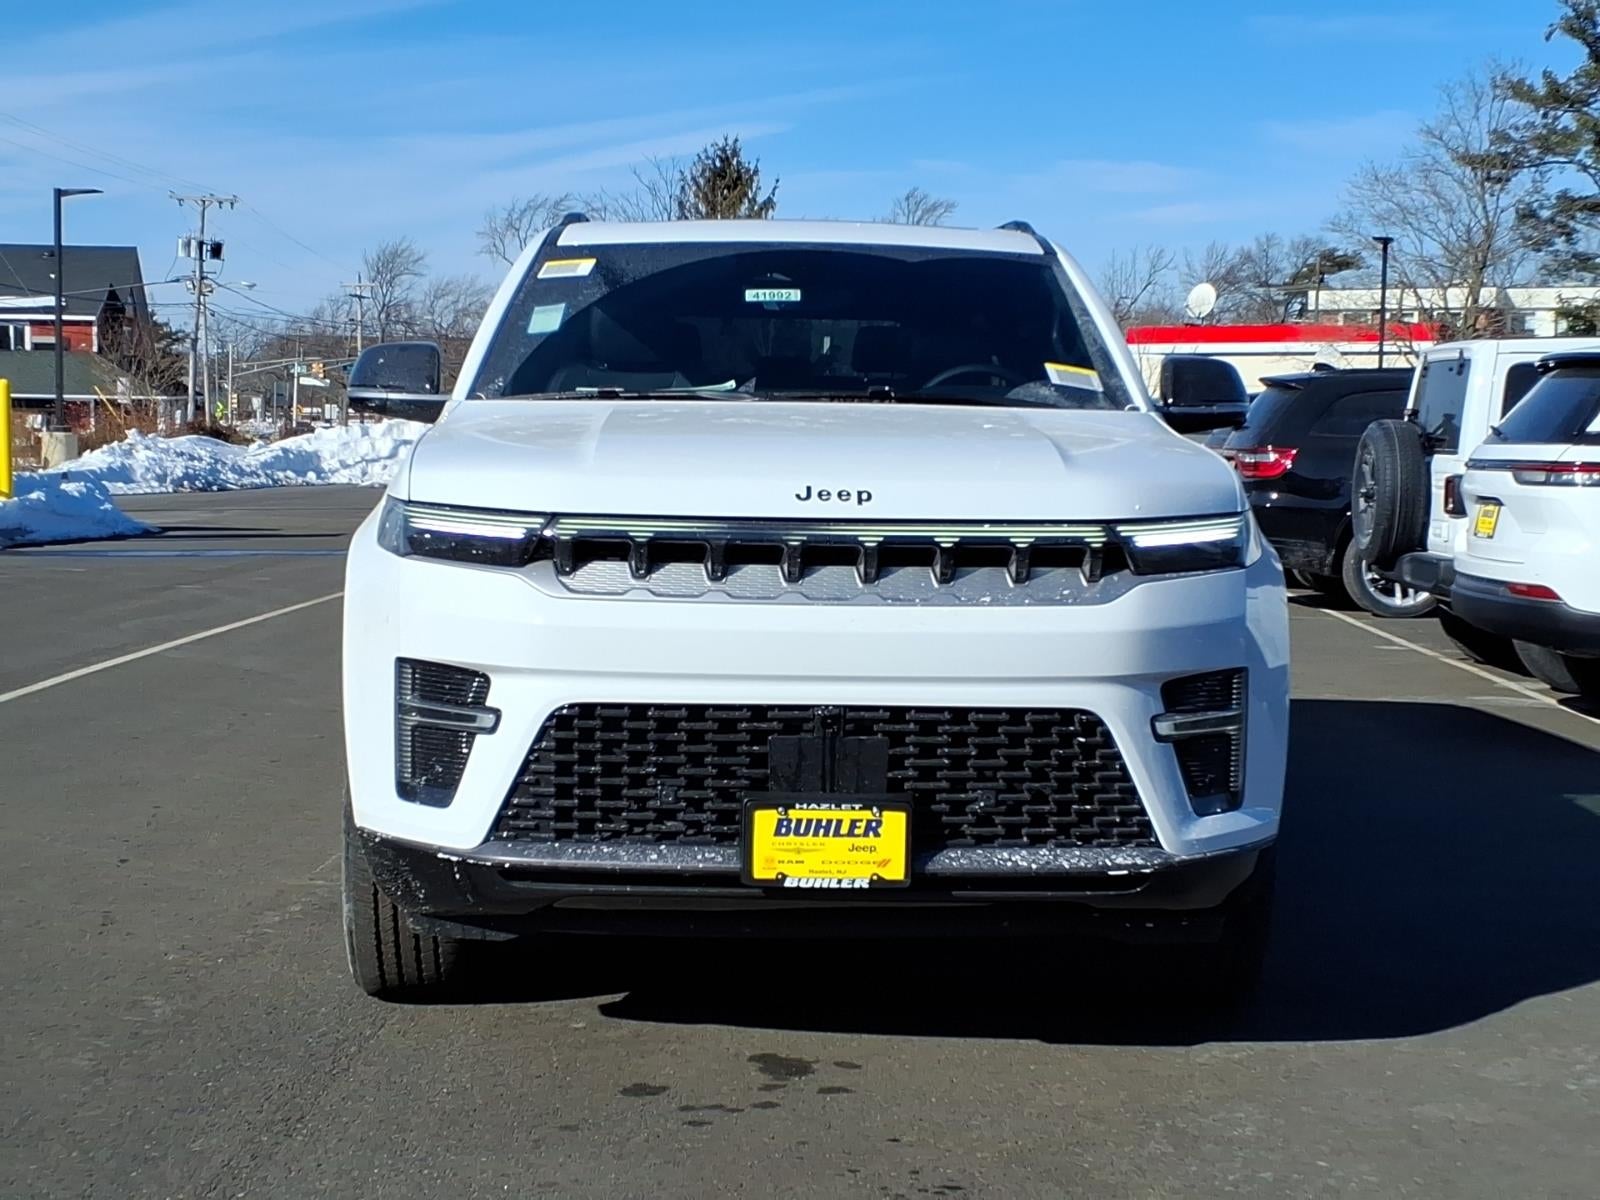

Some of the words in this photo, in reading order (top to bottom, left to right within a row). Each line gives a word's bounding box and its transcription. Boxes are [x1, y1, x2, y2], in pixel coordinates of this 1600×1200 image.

[795, 485, 873, 506] Jeep
[795, 803, 864, 811] HAZLET
[774, 818, 883, 838] BUHLER
[848, 843, 877, 854] Jeep
[783, 877, 870, 888] BUHLER
